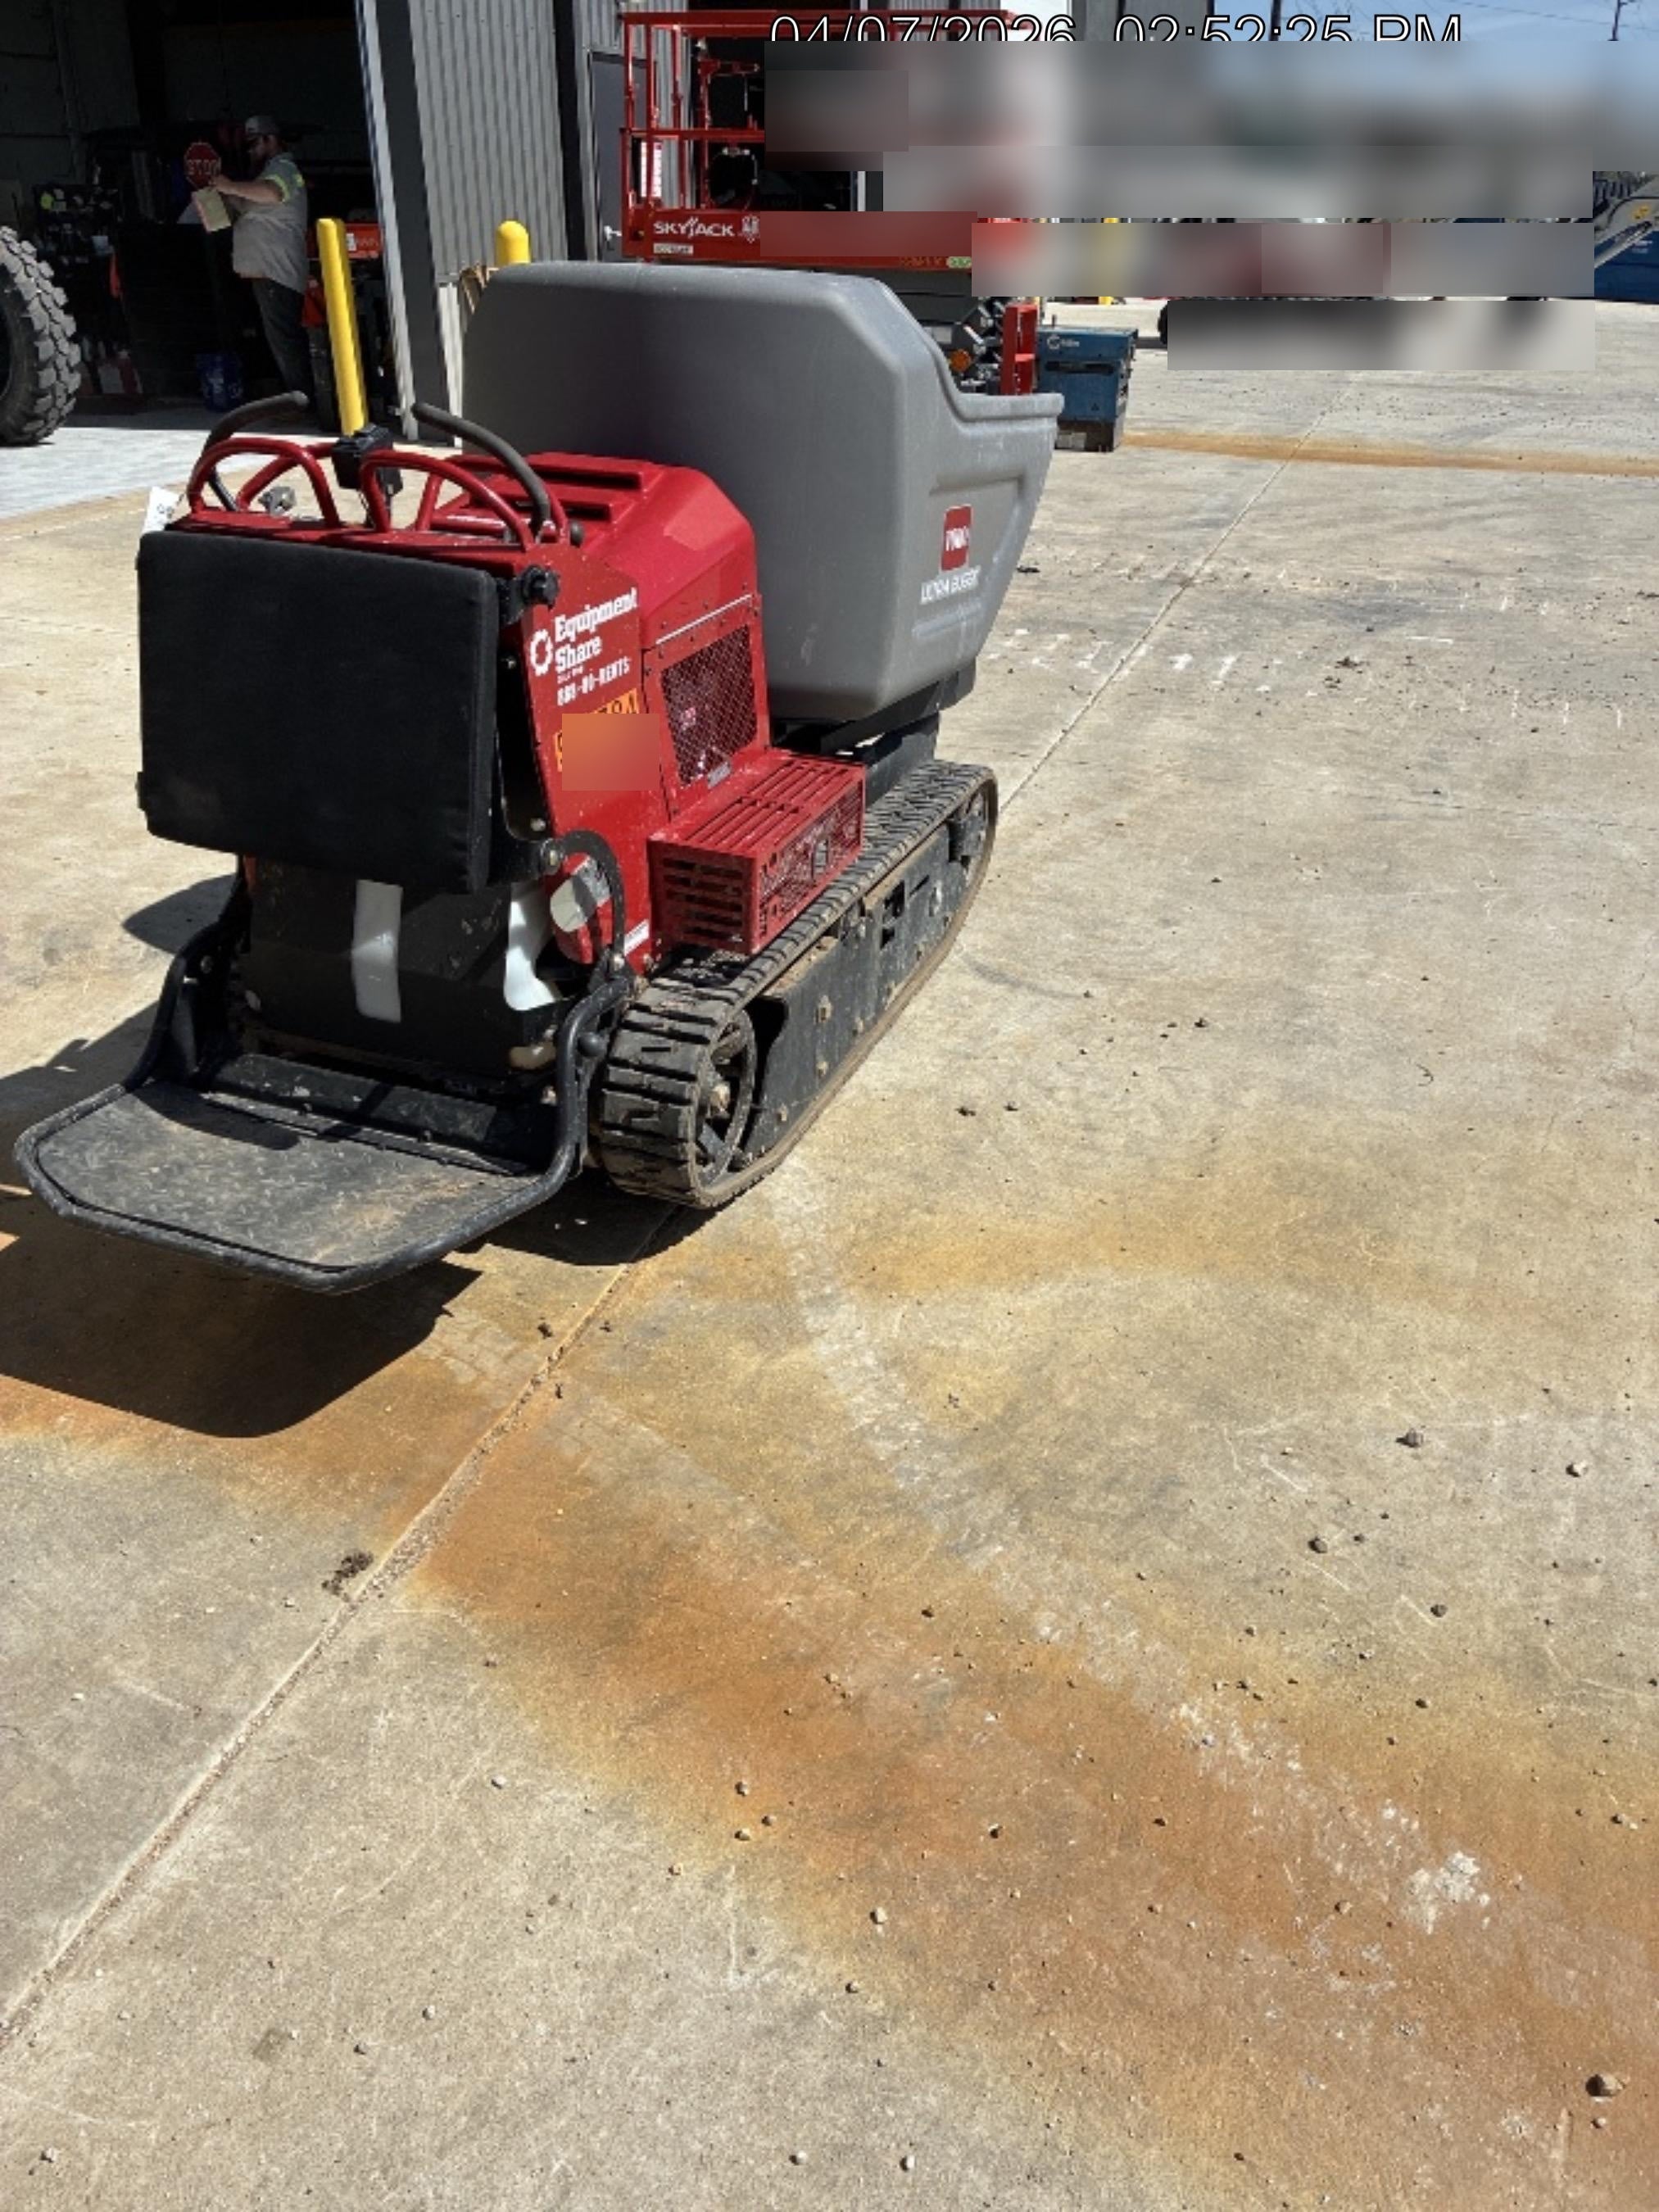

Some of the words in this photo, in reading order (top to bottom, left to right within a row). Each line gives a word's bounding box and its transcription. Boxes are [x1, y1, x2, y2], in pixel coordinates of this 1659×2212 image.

[186, 158, 221, 176] STOP
[653, 215, 736, 239] SKYJACK
[555, 587, 637, 643] Equipment
[555, 635, 603, 673] Share
